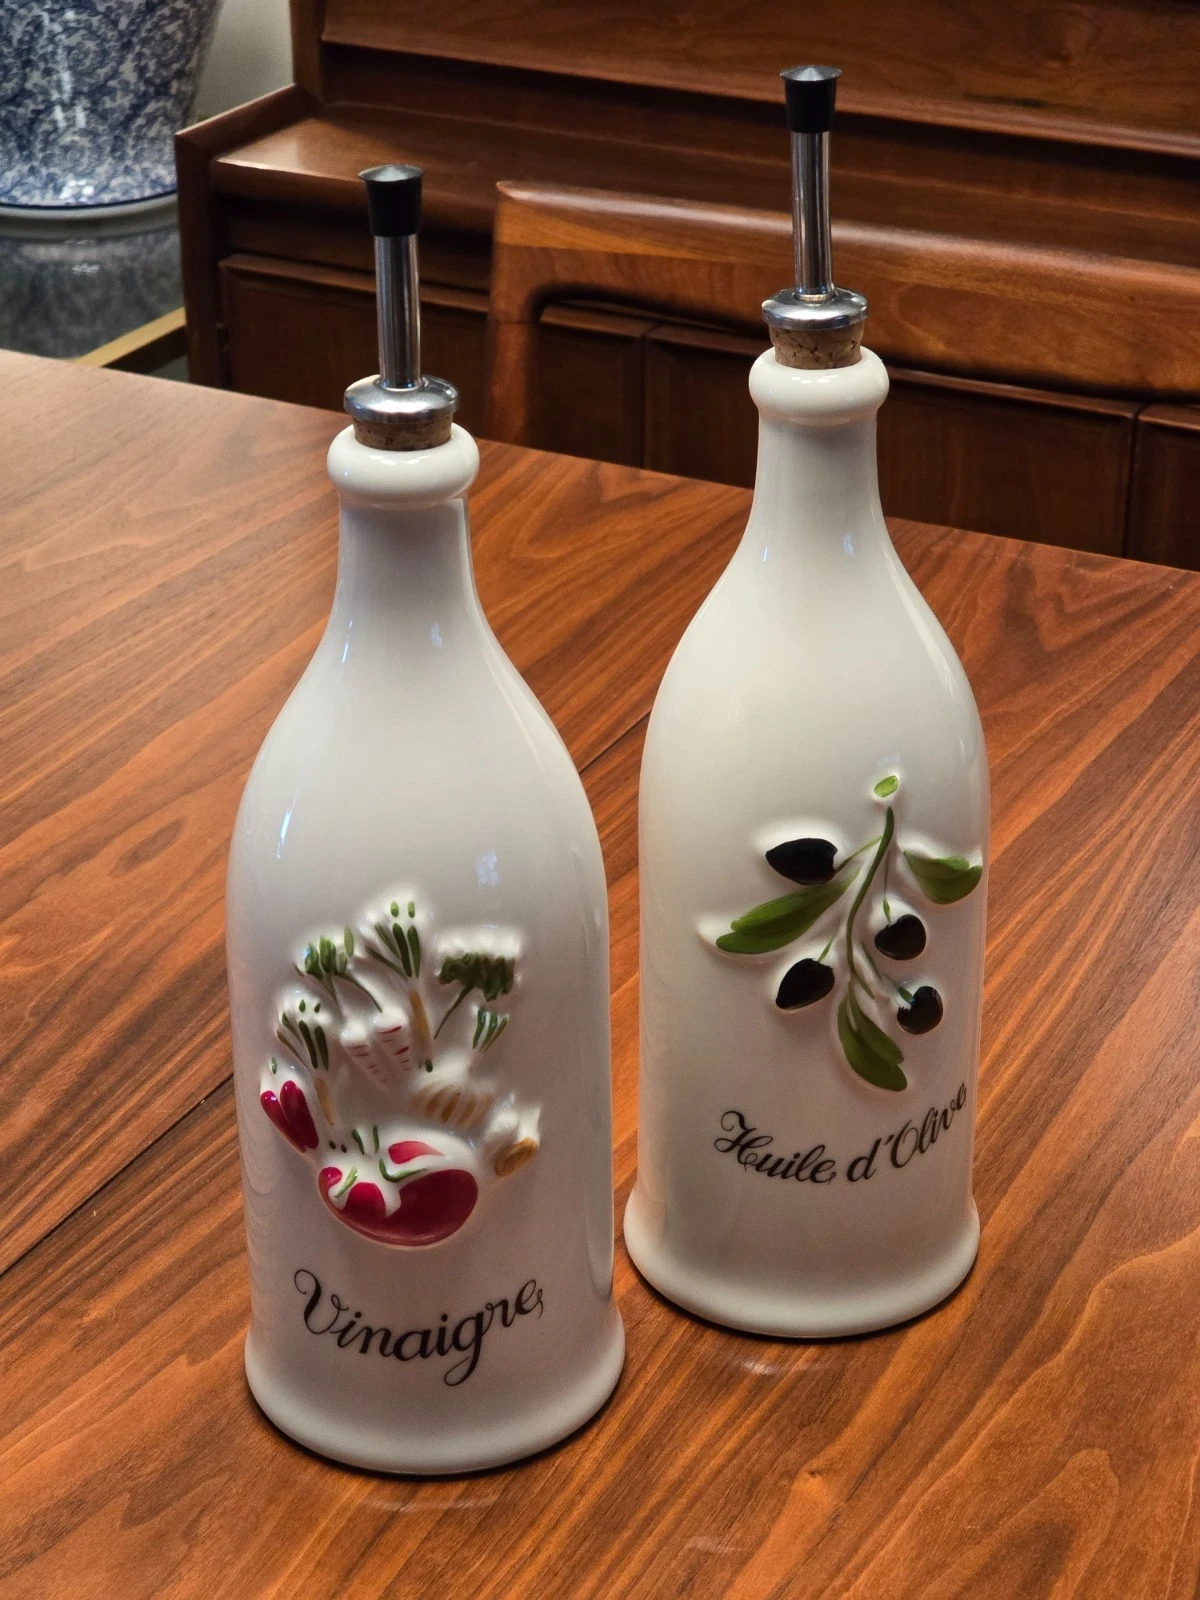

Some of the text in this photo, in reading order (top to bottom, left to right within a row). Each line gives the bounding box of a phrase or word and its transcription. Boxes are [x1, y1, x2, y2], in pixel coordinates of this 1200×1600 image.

[714, 1082, 967, 1185] Huile d'Olive
[293, 1268, 544, 1387] Vinaigre
